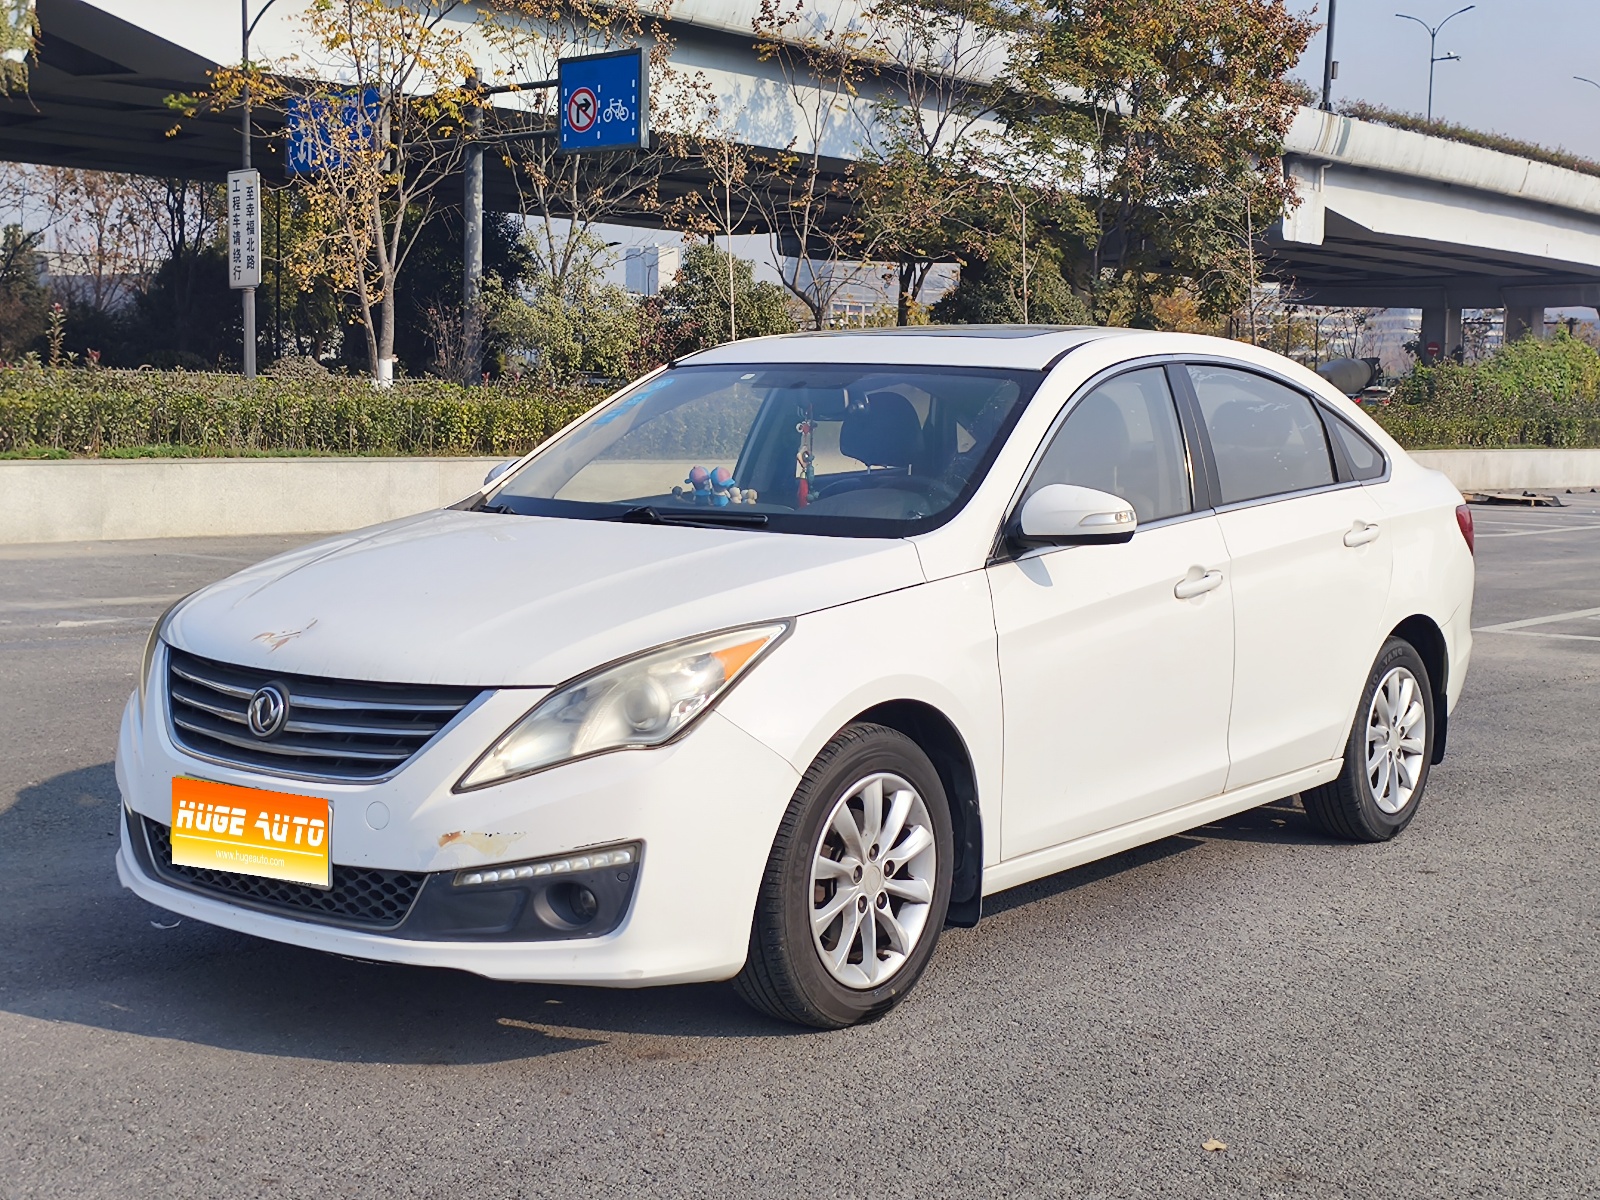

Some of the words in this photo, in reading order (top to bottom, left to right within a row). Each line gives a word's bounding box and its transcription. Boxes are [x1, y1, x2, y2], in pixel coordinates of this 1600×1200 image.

[232, 179, 242, 281] 工程车请绕行
[246, 186, 255, 270] 至幸福北路
